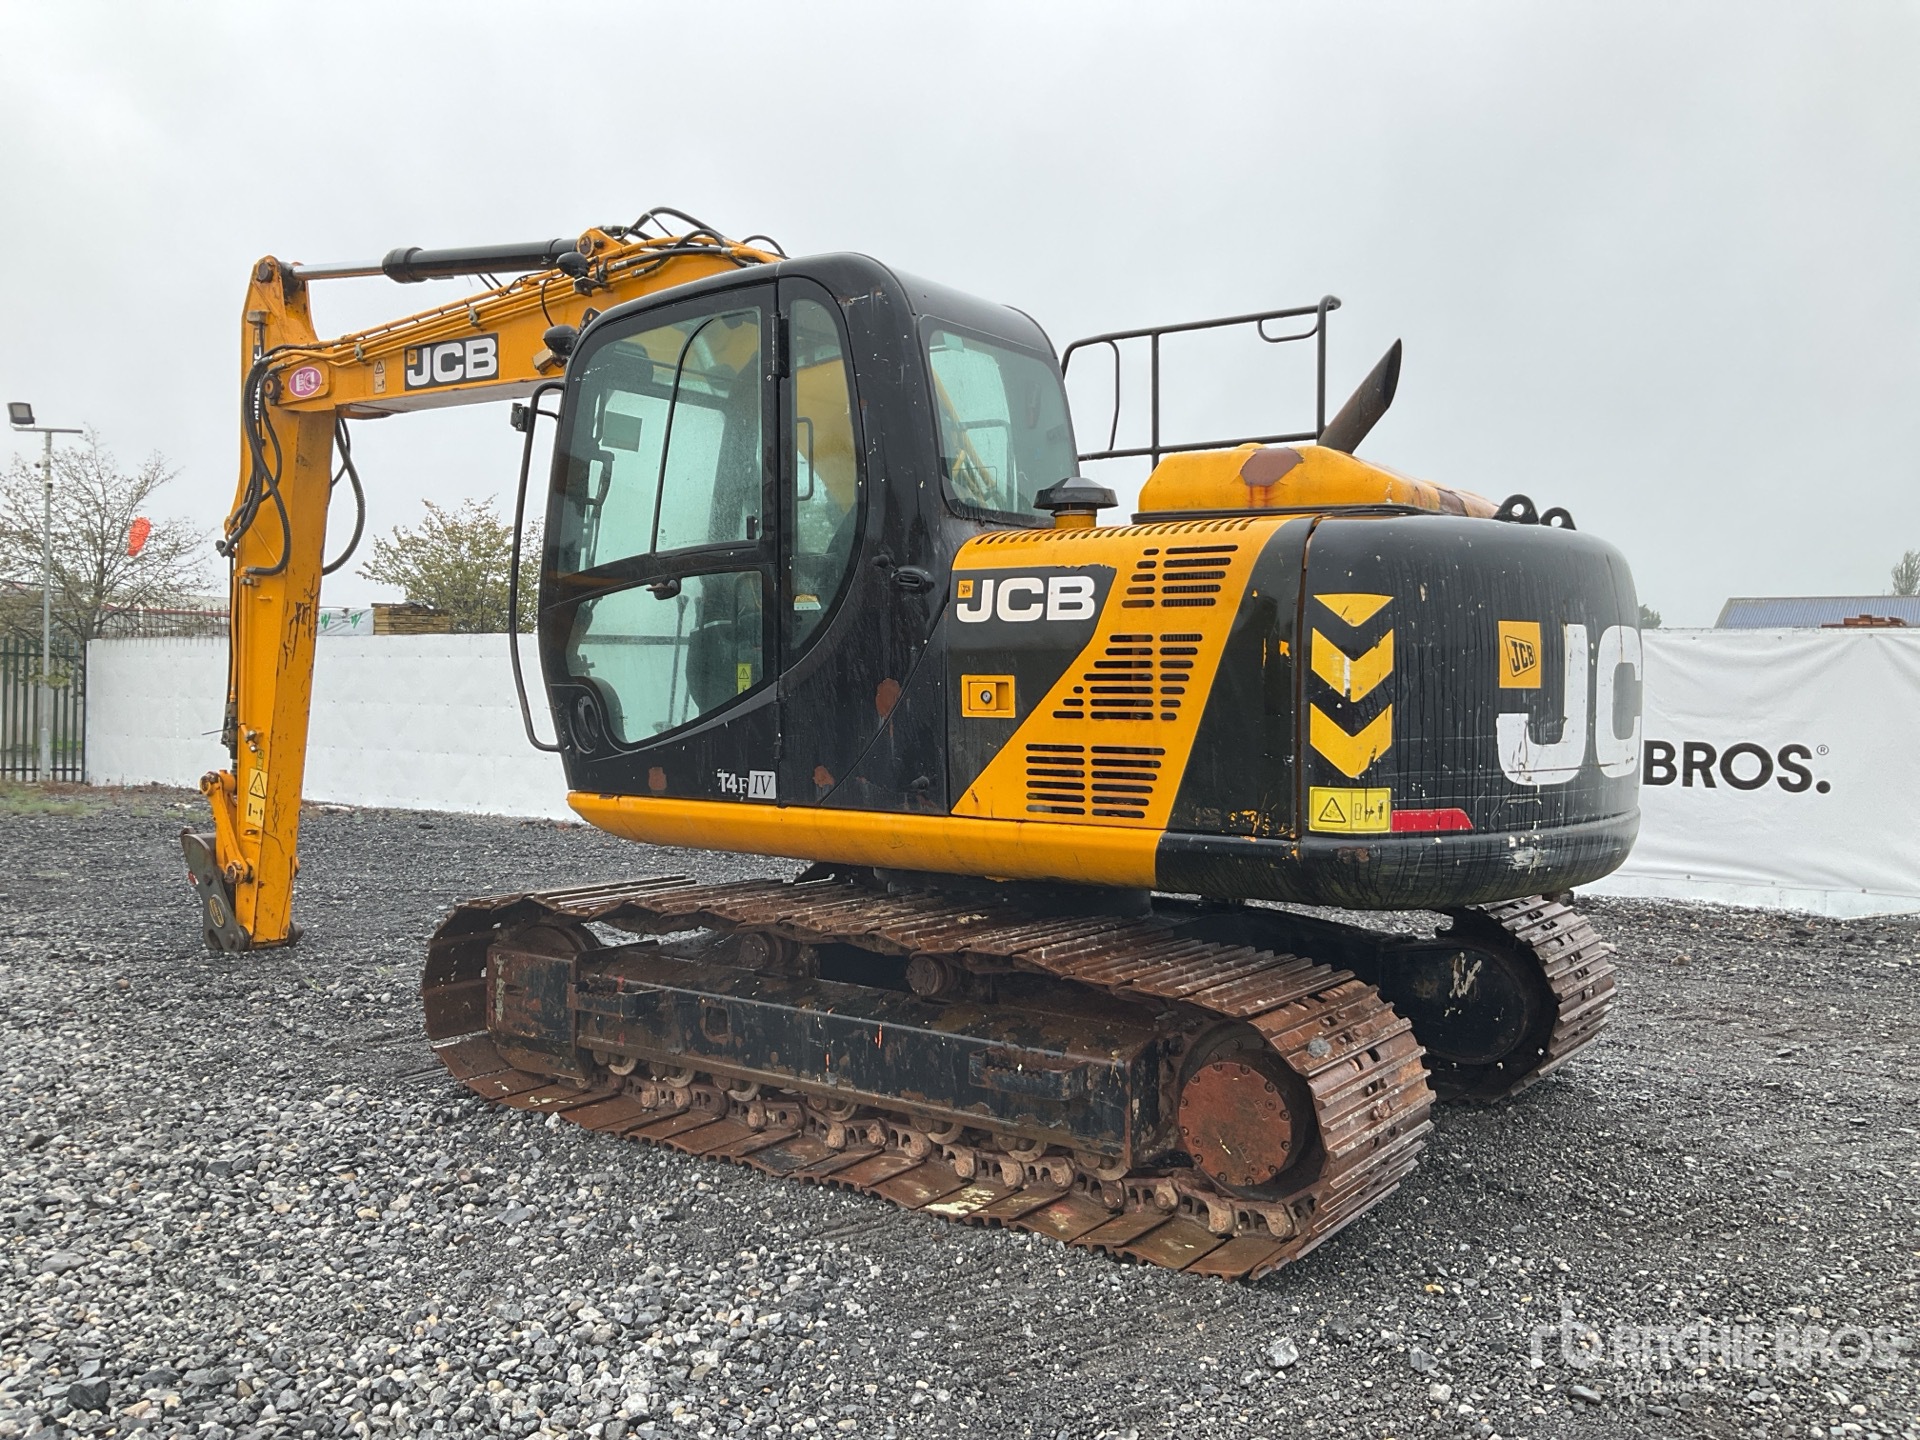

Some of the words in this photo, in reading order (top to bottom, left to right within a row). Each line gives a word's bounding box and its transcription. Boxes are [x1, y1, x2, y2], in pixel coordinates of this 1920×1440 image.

[407, 337, 497, 386] JCB
[956, 576, 1095, 623] JCB
[1510, 641, 1535, 672] JCB
